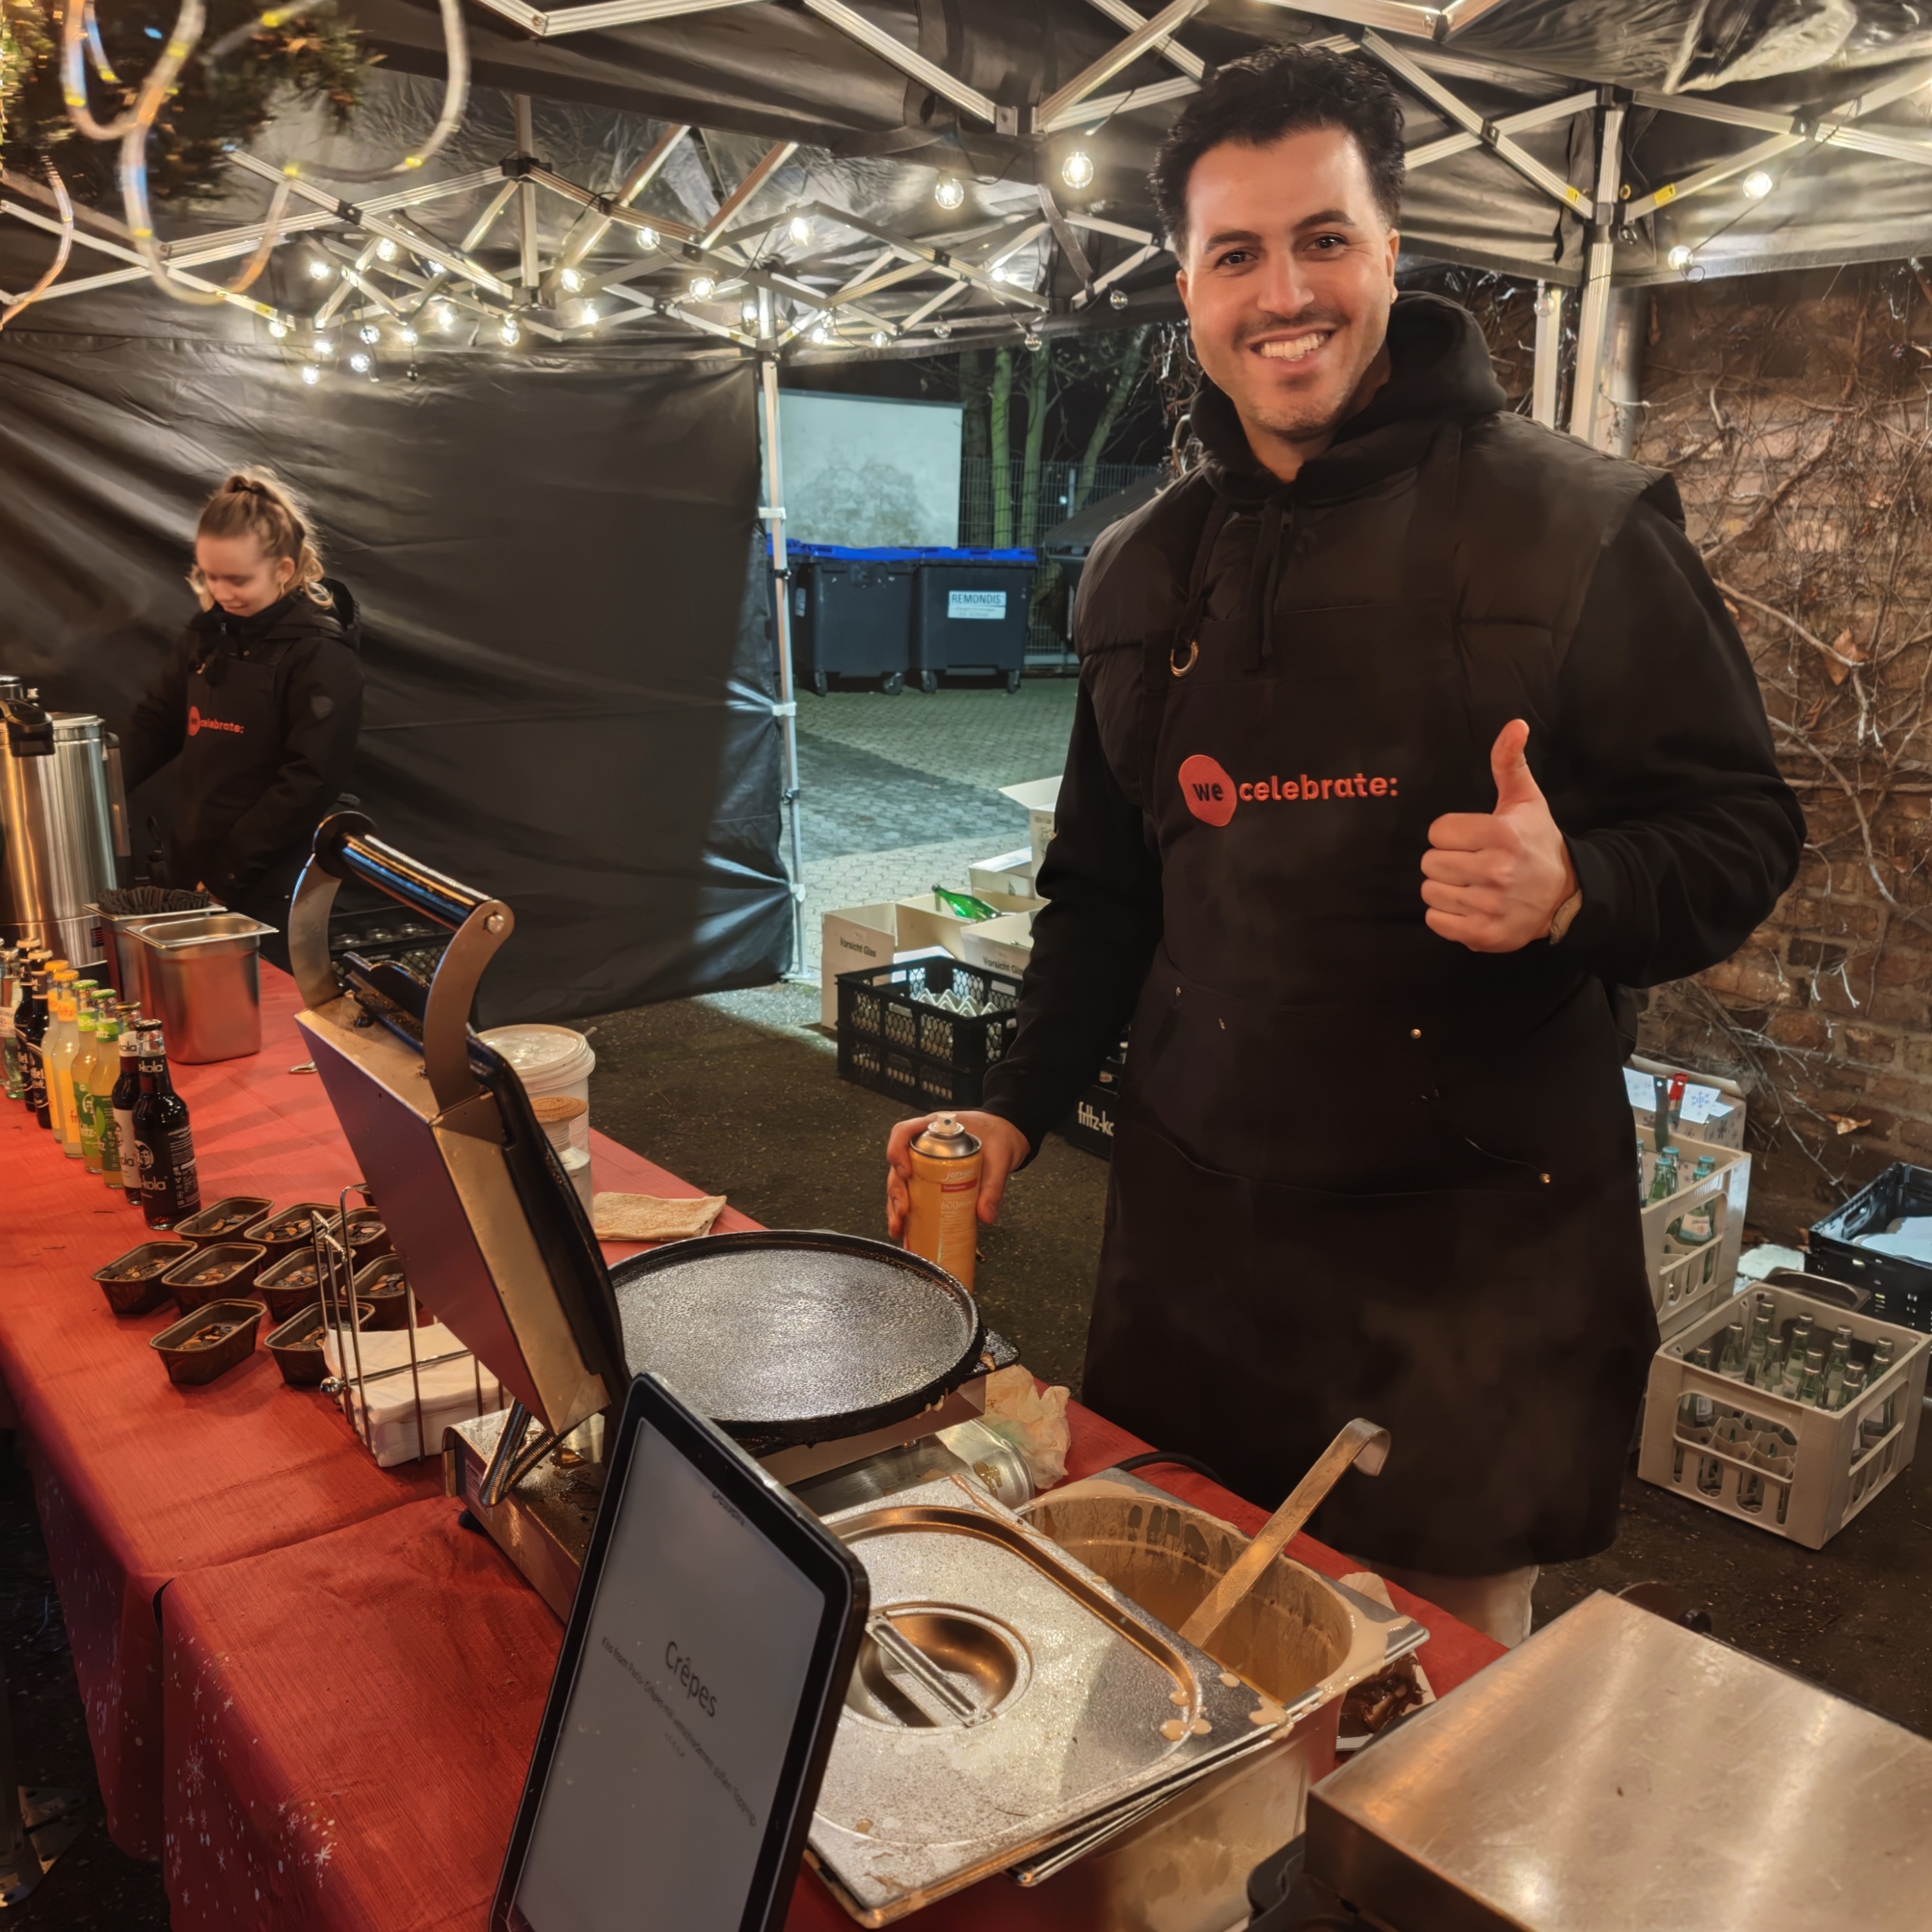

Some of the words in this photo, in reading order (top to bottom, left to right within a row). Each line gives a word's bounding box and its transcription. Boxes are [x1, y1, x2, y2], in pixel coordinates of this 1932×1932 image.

[951, 593, 1001, 605] REMONDIS
[1191, 782, 1224, 802] we
[1238, 772, 1399, 802] celebrate:
[840, 936, 863, 953] Vorsicht
[864, 945, 876, 958] Glas
[982, 955, 1010, 972] Vorsicht
[665, 1640, 717, 1718] Crêpes
